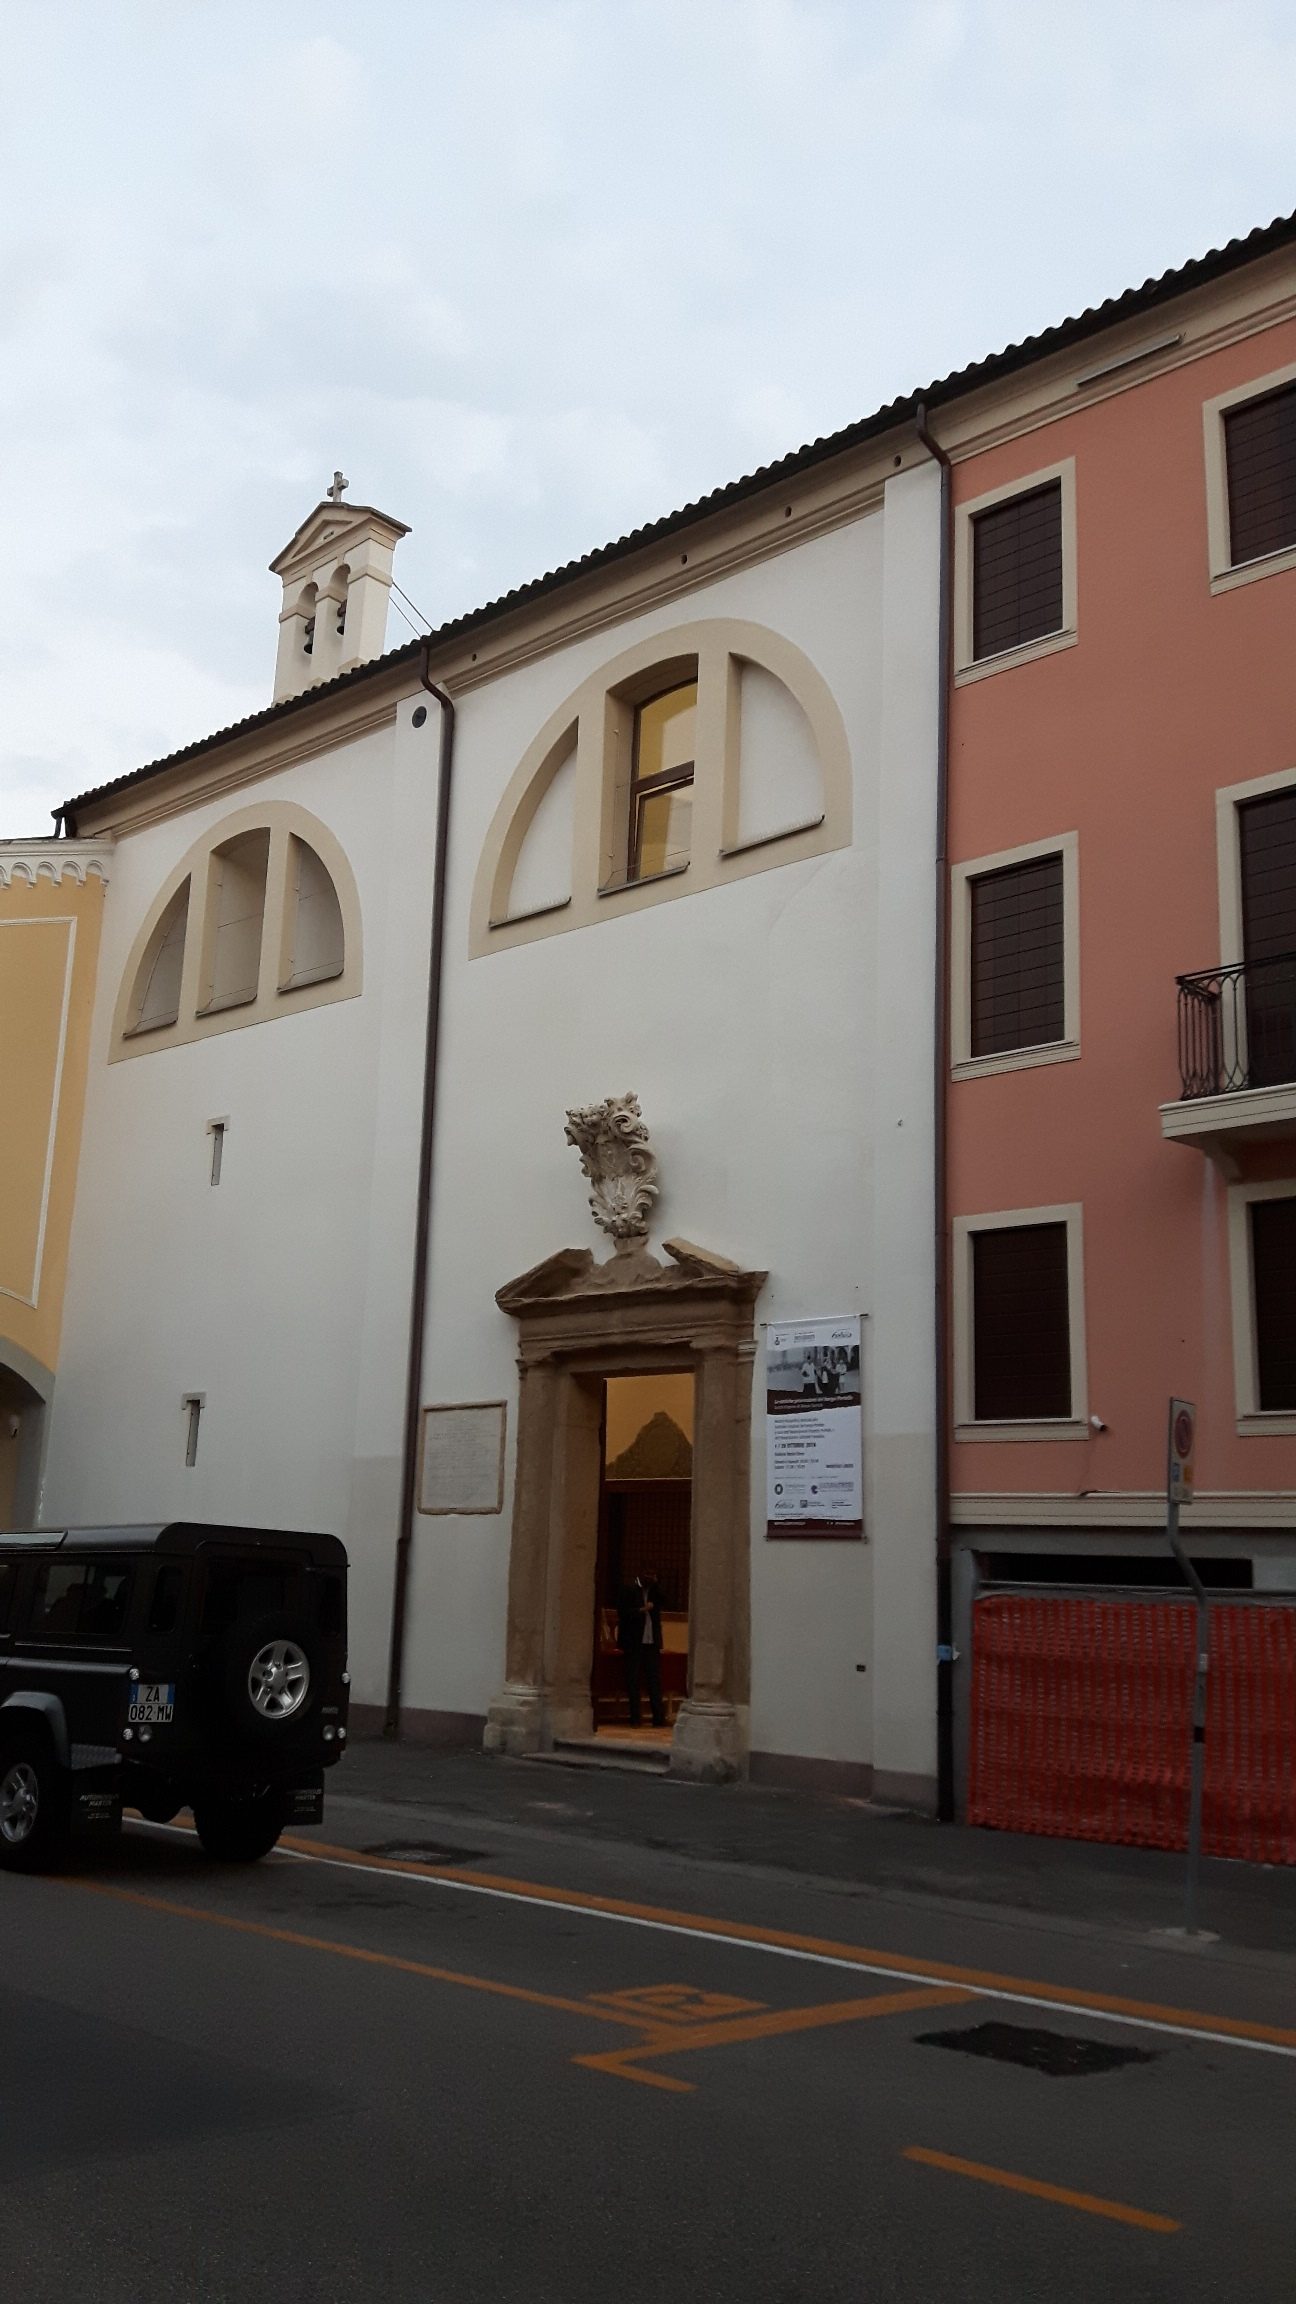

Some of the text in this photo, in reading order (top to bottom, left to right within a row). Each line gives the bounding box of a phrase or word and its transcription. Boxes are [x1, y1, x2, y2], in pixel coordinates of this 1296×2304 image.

[145, 1686, 160, 1703] ZA
[130, 1704, 172, 1721] 082 MW
